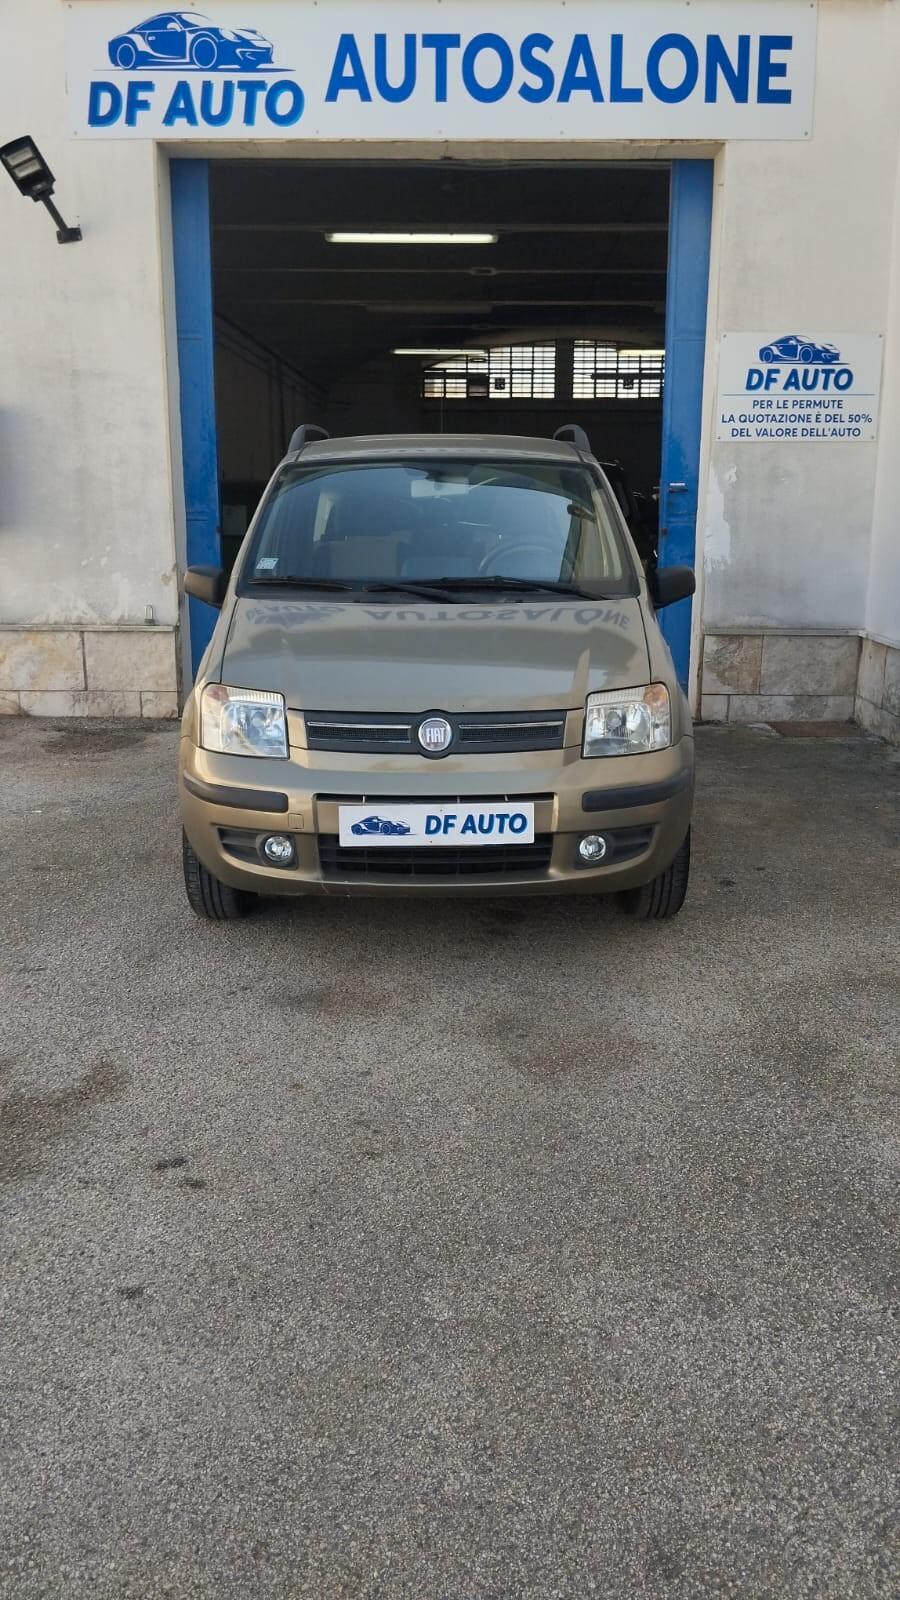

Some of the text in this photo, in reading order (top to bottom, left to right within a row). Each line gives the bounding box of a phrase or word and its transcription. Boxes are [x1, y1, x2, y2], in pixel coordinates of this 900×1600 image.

[325, 32, 793, 104] AUTOSALONE
[88, 79, 305, 127] DF AUTO
[745, 368, 854, 391] DF AUTO
[752, 400, 844, 409] PER LE PERMUTE
[721, 414, 735, 423] LA
[738, 413, 812, 424] QUOTAZIONE
[824, 414, 845, 423] DEL
[848, 413, 873, 423] 50%
[731, 428, 861, 437] DEL VALORE DELL'AUTO
[425, 727, 446, 743] FIAT
[424, 813, 528, 835] DF AUTO
